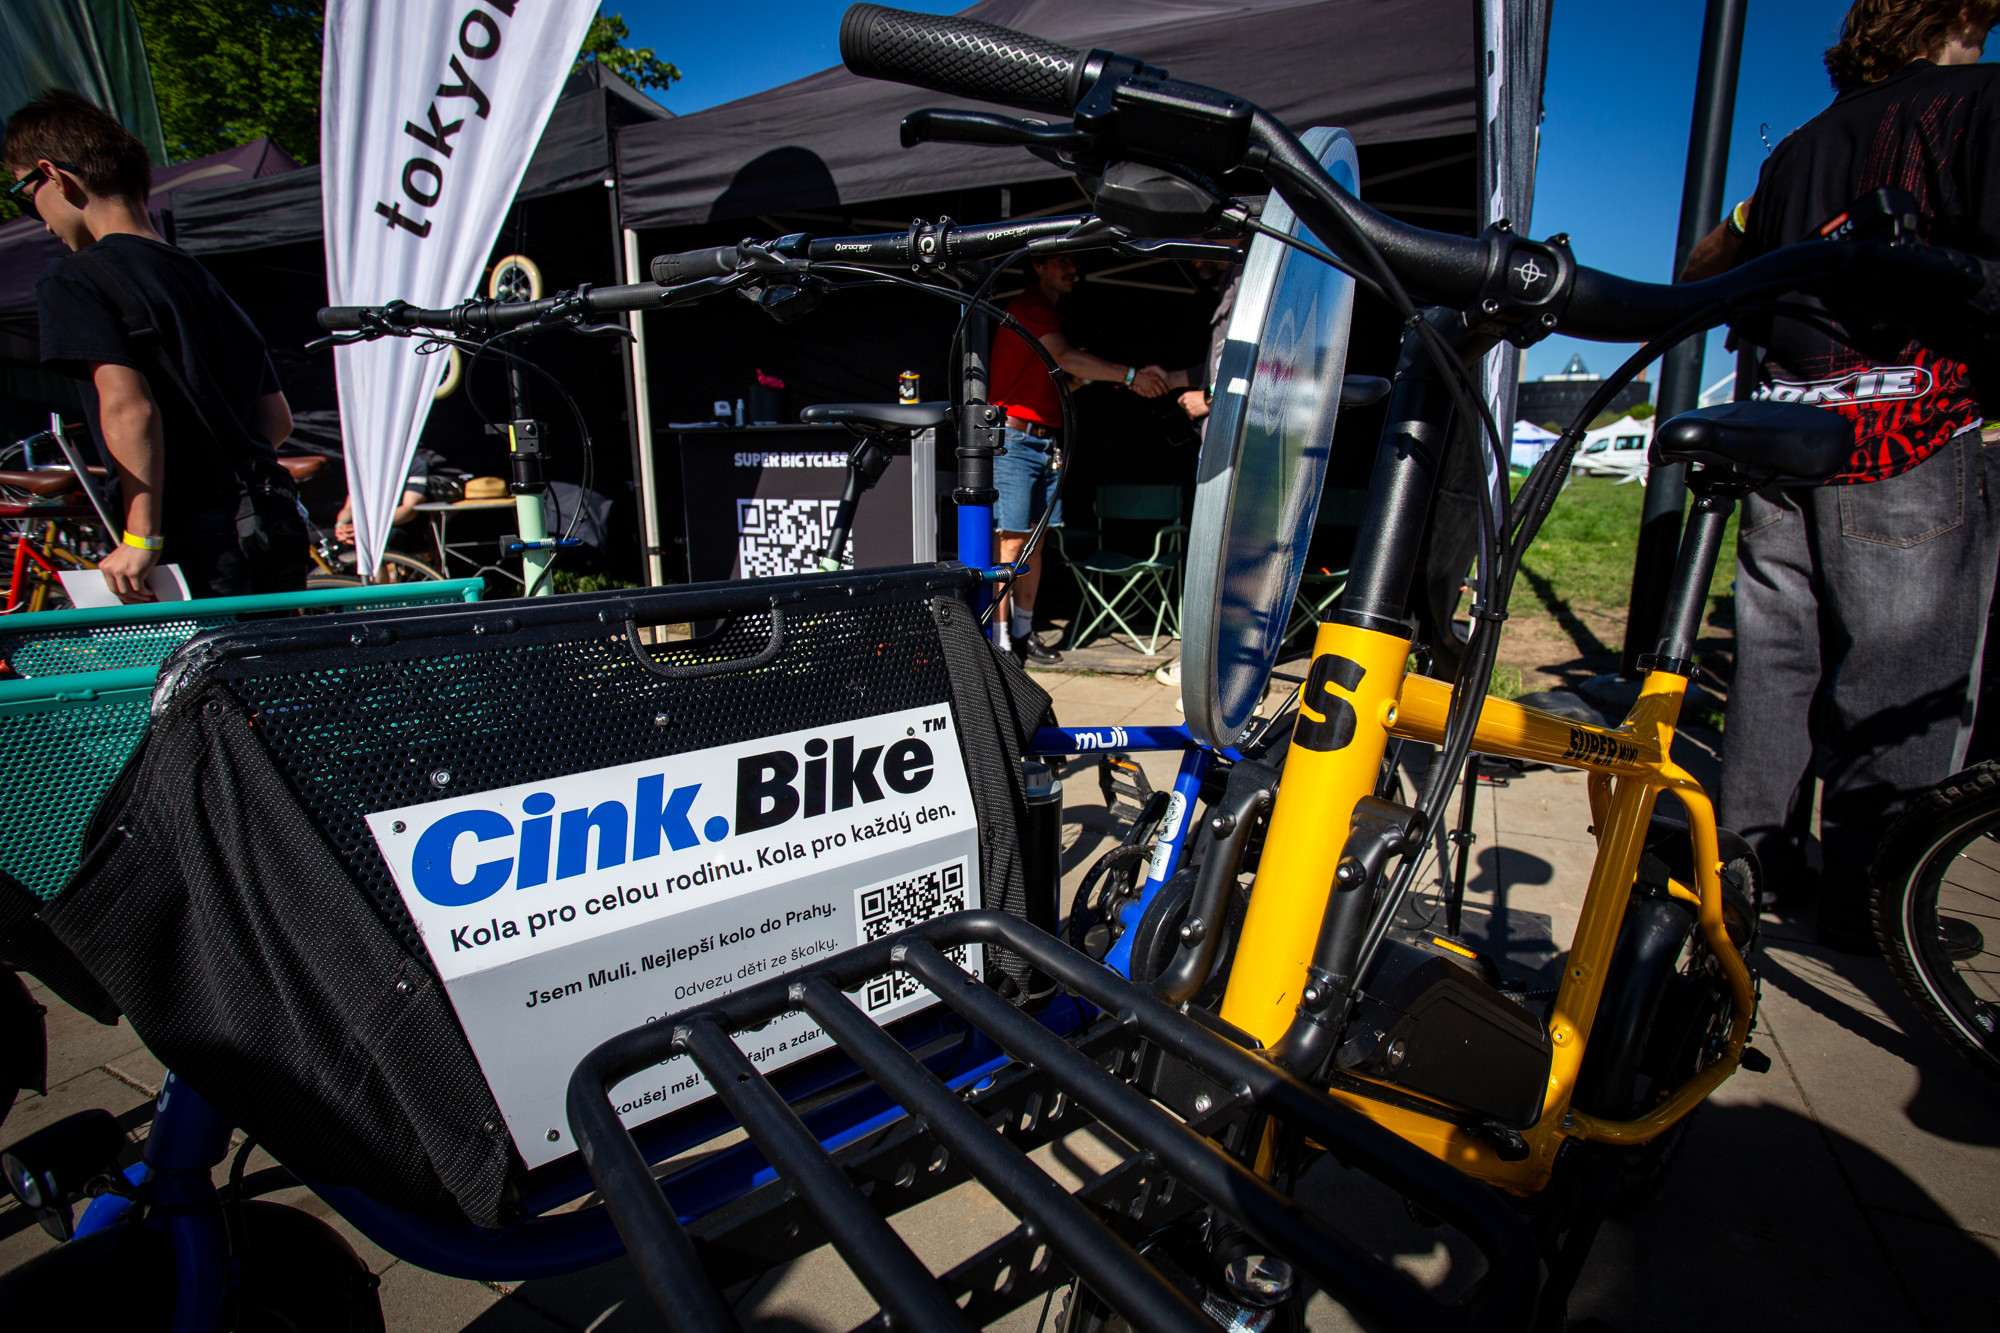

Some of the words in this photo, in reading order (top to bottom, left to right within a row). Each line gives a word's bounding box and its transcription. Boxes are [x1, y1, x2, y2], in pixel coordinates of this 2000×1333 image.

[375, 0, 520, 238] tokyo
[734, 452, 780, 468] SUPER
[780, 451, 849, 468] BICYCLES
[1292, 653, 1366, 752] S
[1075, 727, 1128, 750] muli
[1562, 728, 1617, 767] SUPER
[450, 918, 519, 952] Kola
[527, 904, 576, 937] pro
[585, 882, 658, 914] celou
[665, 859, 752, 893] rodinu.
[756, 842, 806, 868] Kola
[811, 832, 847, 858] pro
[851, 811, 911, 843] každý
[915, 804, 956, 825] den.
[526, 980, 582, 1008] Jsem
[588, 962, 637, 988] Muli.
[641, 935, 715, 972] Nejlepší
[719, 925, 755, 947] kolo
[760, 918, 782, 934] do
[786, 902, 837, 926] Prahy.
[674, 971, 732, 1000] Odvezu
[737, 959, 767, 979] děti
[770, 954, 787, 969] ze
[791, 936, 839, 961] školky.
[747, 1046, 775, 1062] fajn
[779, 1042, 787, 1052] a
[791, 1028, 825, 1047] zdar
[671, 1073, 699, 1094] mě!
